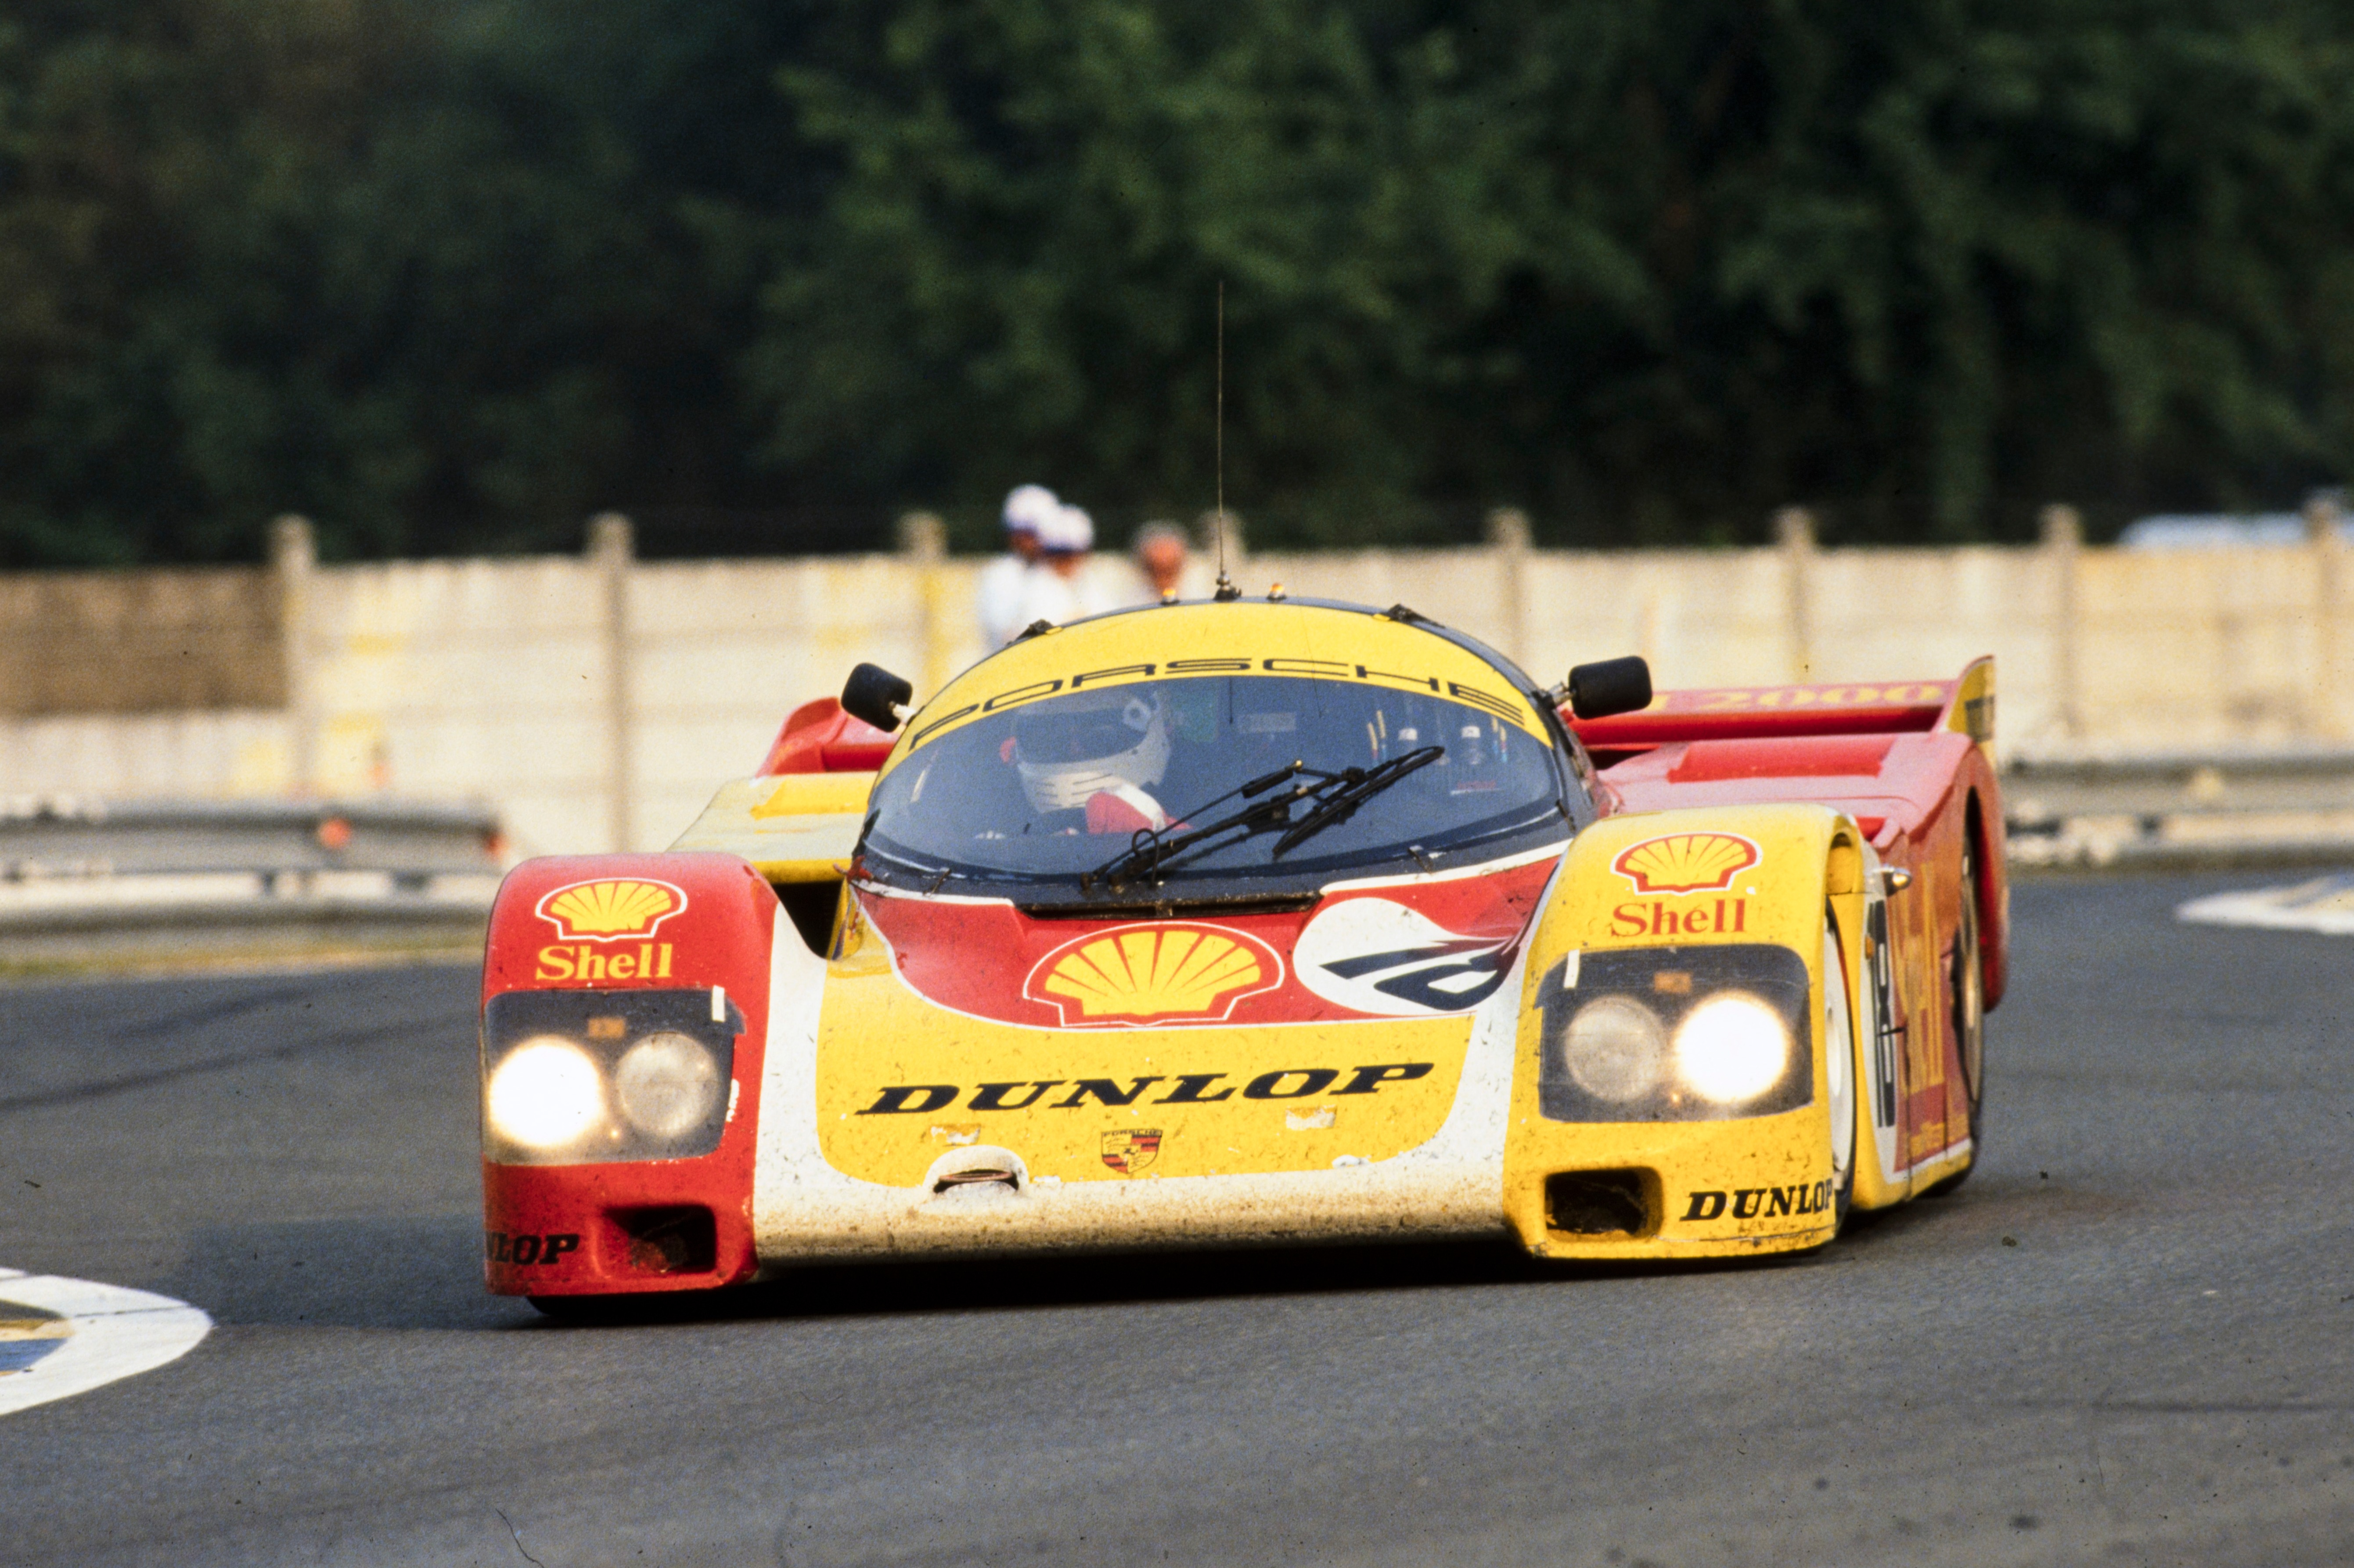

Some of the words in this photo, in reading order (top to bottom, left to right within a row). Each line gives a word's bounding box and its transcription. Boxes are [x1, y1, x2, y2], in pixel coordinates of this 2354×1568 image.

[908, 658, 1525, 752] PORSCHE
[1697, 685, 1942, 711] 2000
[1610, 898, 1746, 937] Shell
[535, 943, 673, 981] Shell
[854, 1061, 1436, 1115] DUNLOP
[1679, 1178, 1833, 1222] DUNLOP
